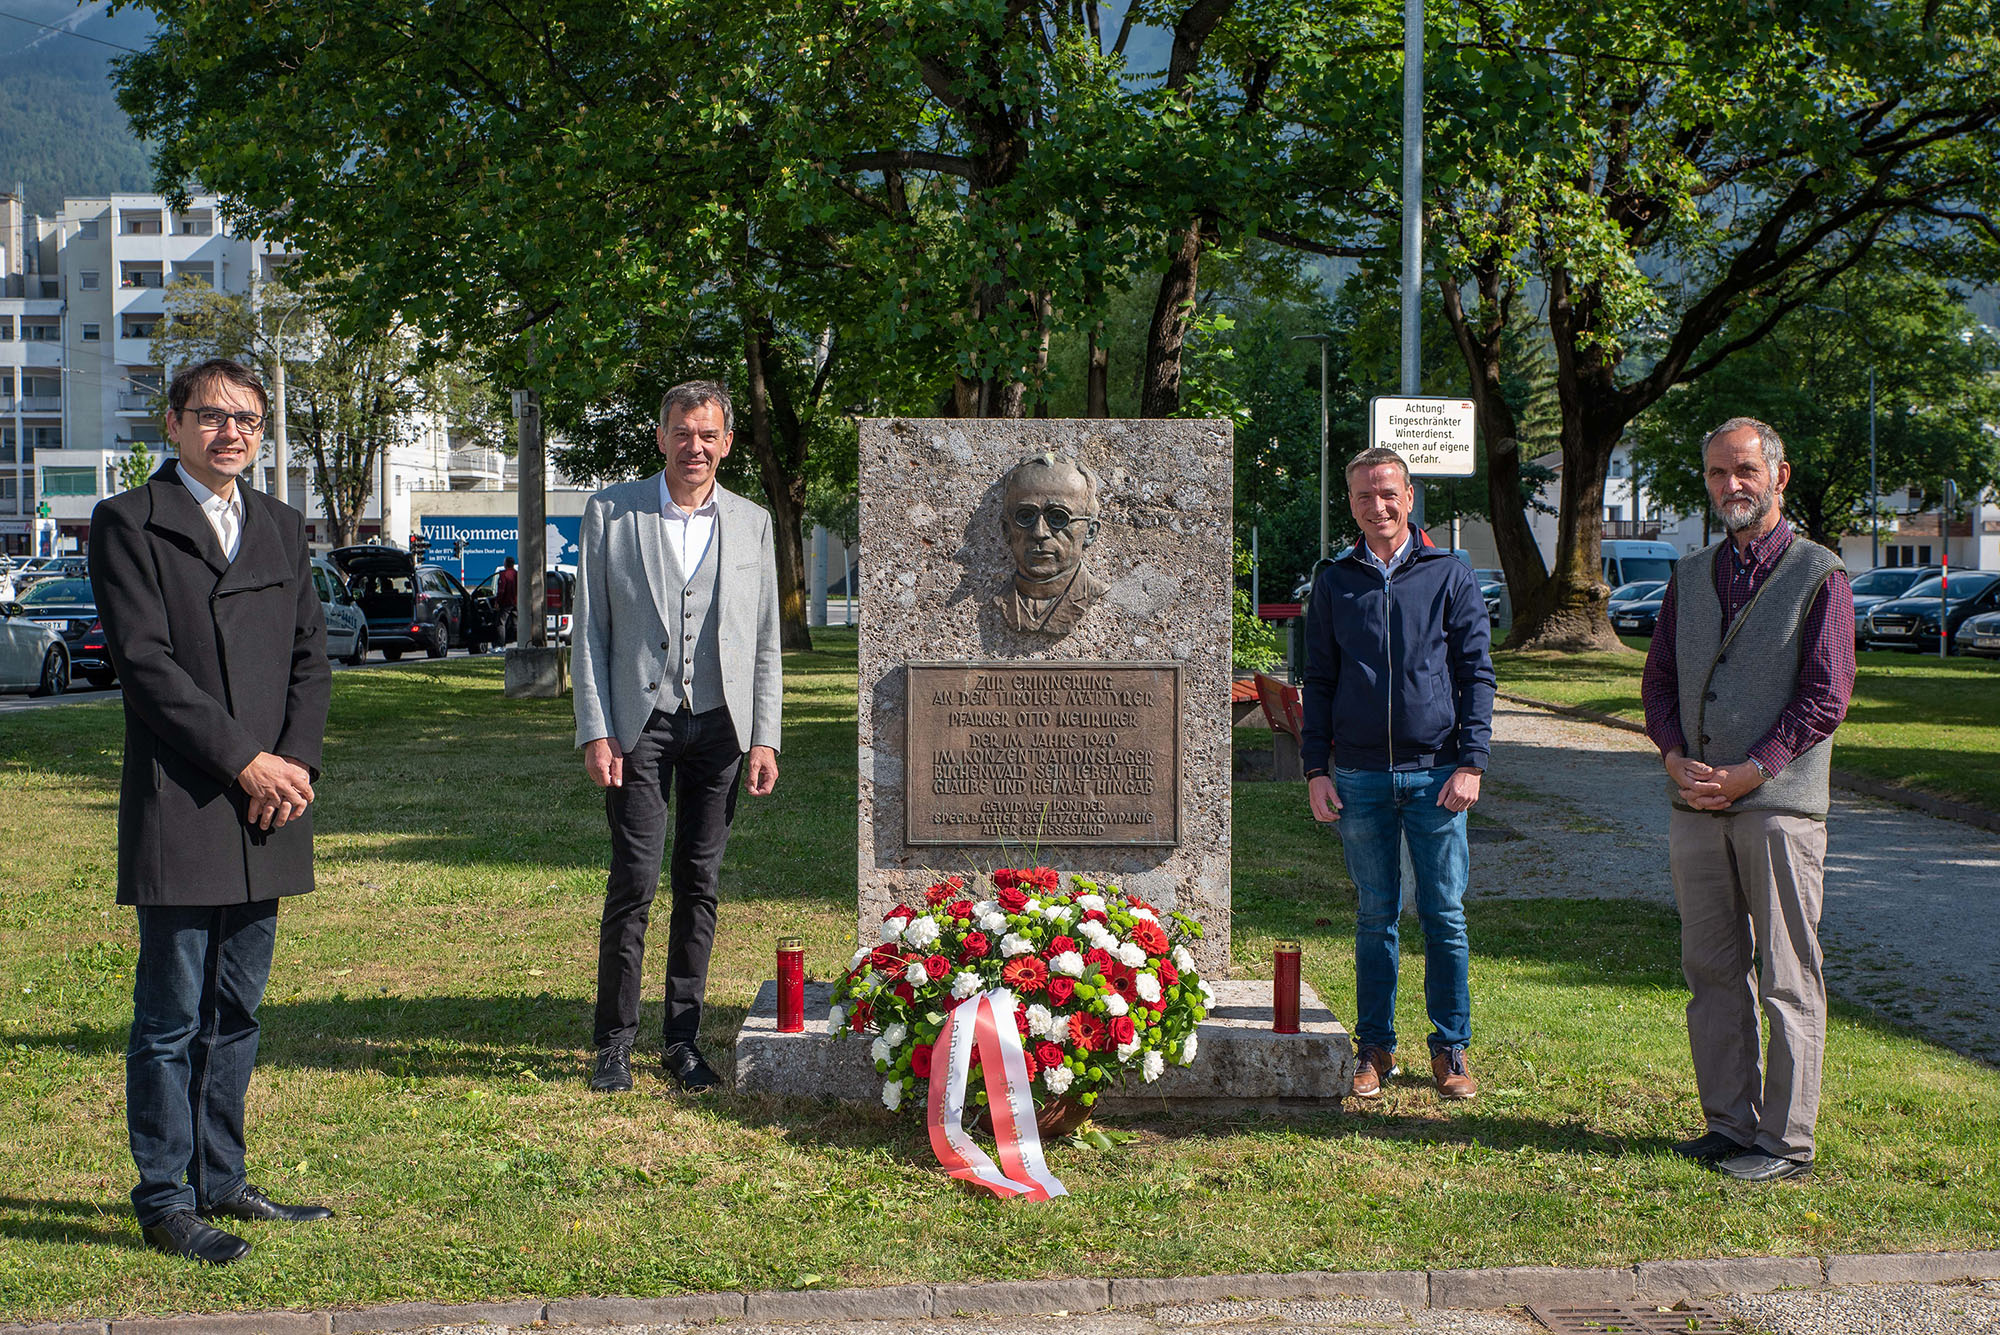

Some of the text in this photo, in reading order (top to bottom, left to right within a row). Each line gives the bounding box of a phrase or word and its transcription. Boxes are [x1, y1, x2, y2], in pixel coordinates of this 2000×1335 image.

[1405, 403, 1445, 416] Achtung!
[1389, 415, 1461, 427] Eingeschränkter
[1395, 428, 1455, 439] Winterdienst.
[1380, 440, 1470, 453] Begehen auf eigene
[1409, 453, 1441, 464] Gefahr.
[421, 525, 518, 540] Willkommen
[974, 674, 1113, 691] ZUR ERINNERUNG
[932, 690, 954, 706] AN
[958, 690, 990, 706] DEN
[995, 690, 1060, 706] TIROLER
[949, 711, 1138, 728] PFARRER OTTO NEURURER
[969, 732, 999, 748] DER
[1003, 732, 1024, 748] IM
[1031, 732, 1078, 748] JAHRE
[933, 748, 1154, 765] IM KONZENTRATIONSLAGER
[933, 764, 1029, 779] BUCHENWALD
[1034, 764, 1069, 779] SEIN
[1074, 764, 1120, 779] LEBEN
[932, 779, 1154, 795] GLAUBE UND HEIMAT HINGAB
[981, 799, 1106, 812] GEWIDMET VON DER
[932, 812, 1019, 825] SPECKBACHER
[981, 824, 1106, 836] ALTER SCHIESSSTAND
